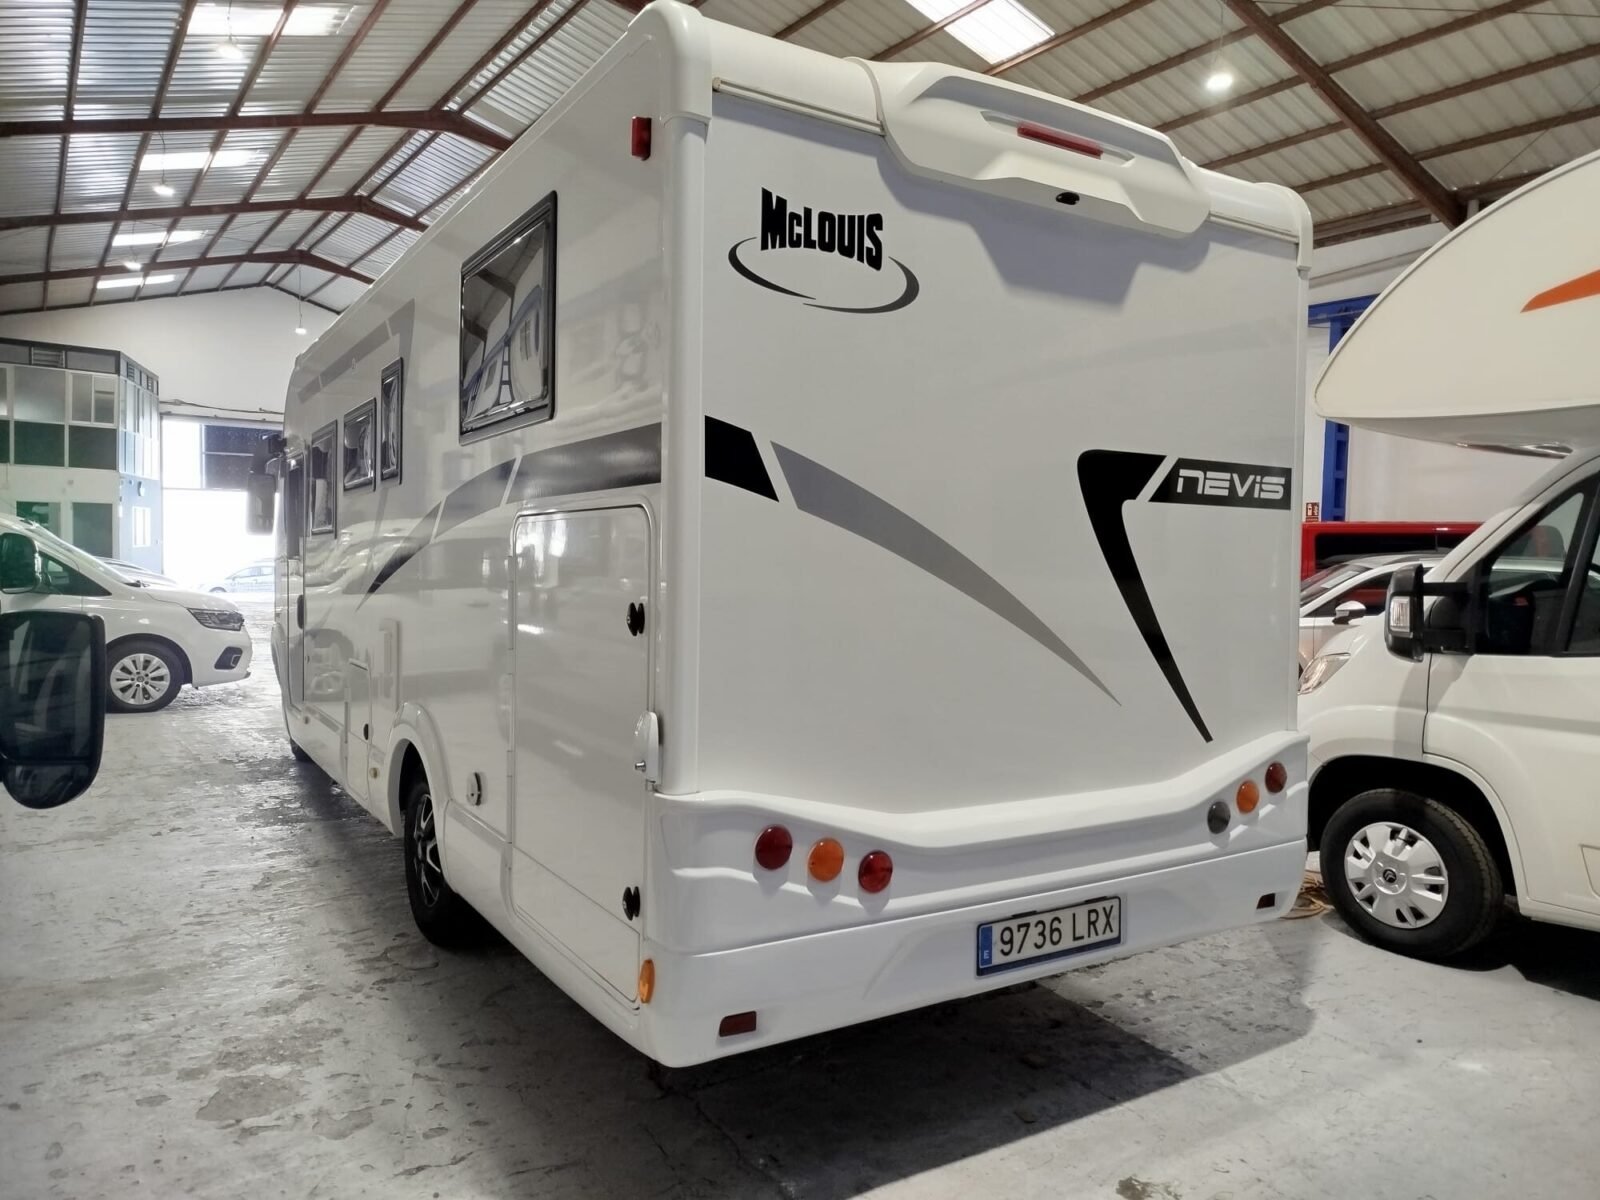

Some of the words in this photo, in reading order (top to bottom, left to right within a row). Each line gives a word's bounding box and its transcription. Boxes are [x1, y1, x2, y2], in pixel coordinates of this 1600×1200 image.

[1000, 916, 1062, 956] 9736
[1072, 905, 1114, 942] LRX
[983, 951, 990, 959] E
